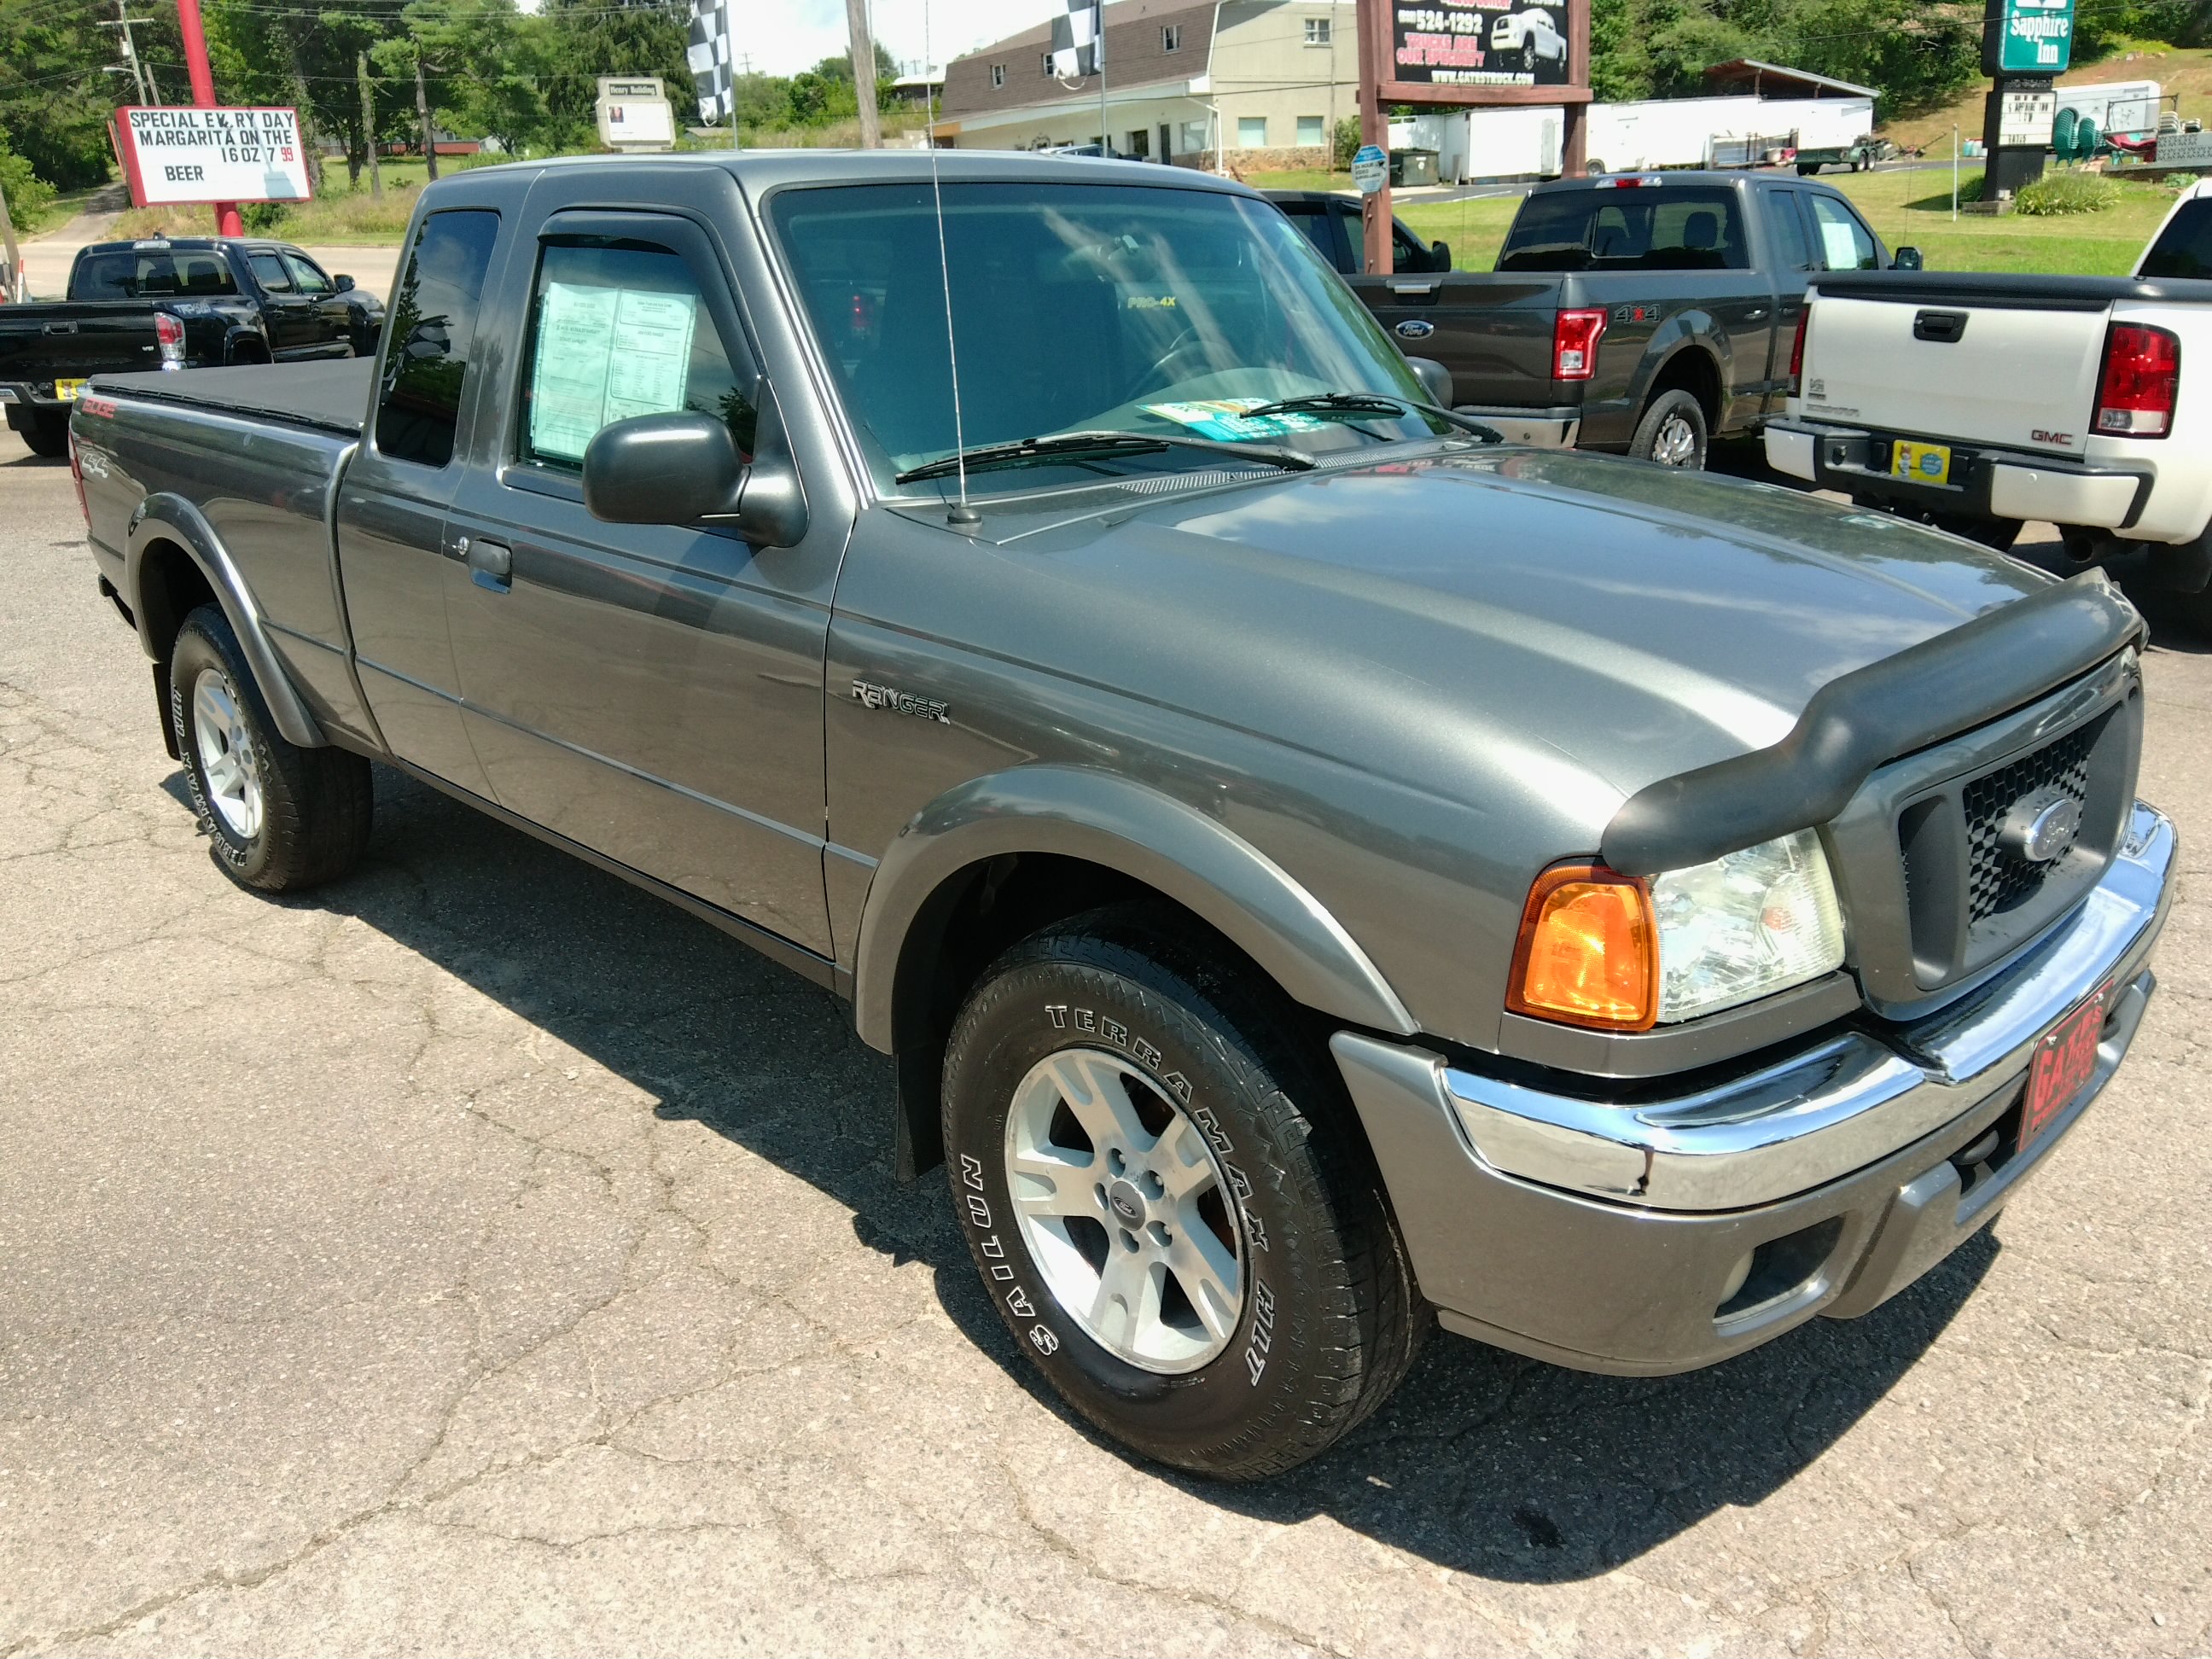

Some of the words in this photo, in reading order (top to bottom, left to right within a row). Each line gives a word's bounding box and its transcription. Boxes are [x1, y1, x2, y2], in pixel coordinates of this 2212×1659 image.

[2010, 9, 2069, 42] Sapphire
[2036, 39, 2058, 64] Inn
[630, 85, 656, 95] Building
[130, 112, 199, 128] SPECIAL
[262, 113, 294, 128] DAY
[139, 130, 236, 146] MARGARITA
[240, 131, 260, 145] ON
[263, 130, 293, 144] THE
[266, 148, 276, 161] 7
[281, 147, 294, 162] 99
[164, 165, 205, 182] BEER
[82, 397, 118, 419] EDGE
[2030, 428, 2074, 445] GMC
[853, 678, 951, 725] RANGER
[1045, 1004, 1272, 1254] TERRAMAX
[959, 1153, 1060, 1357] SAILUN
